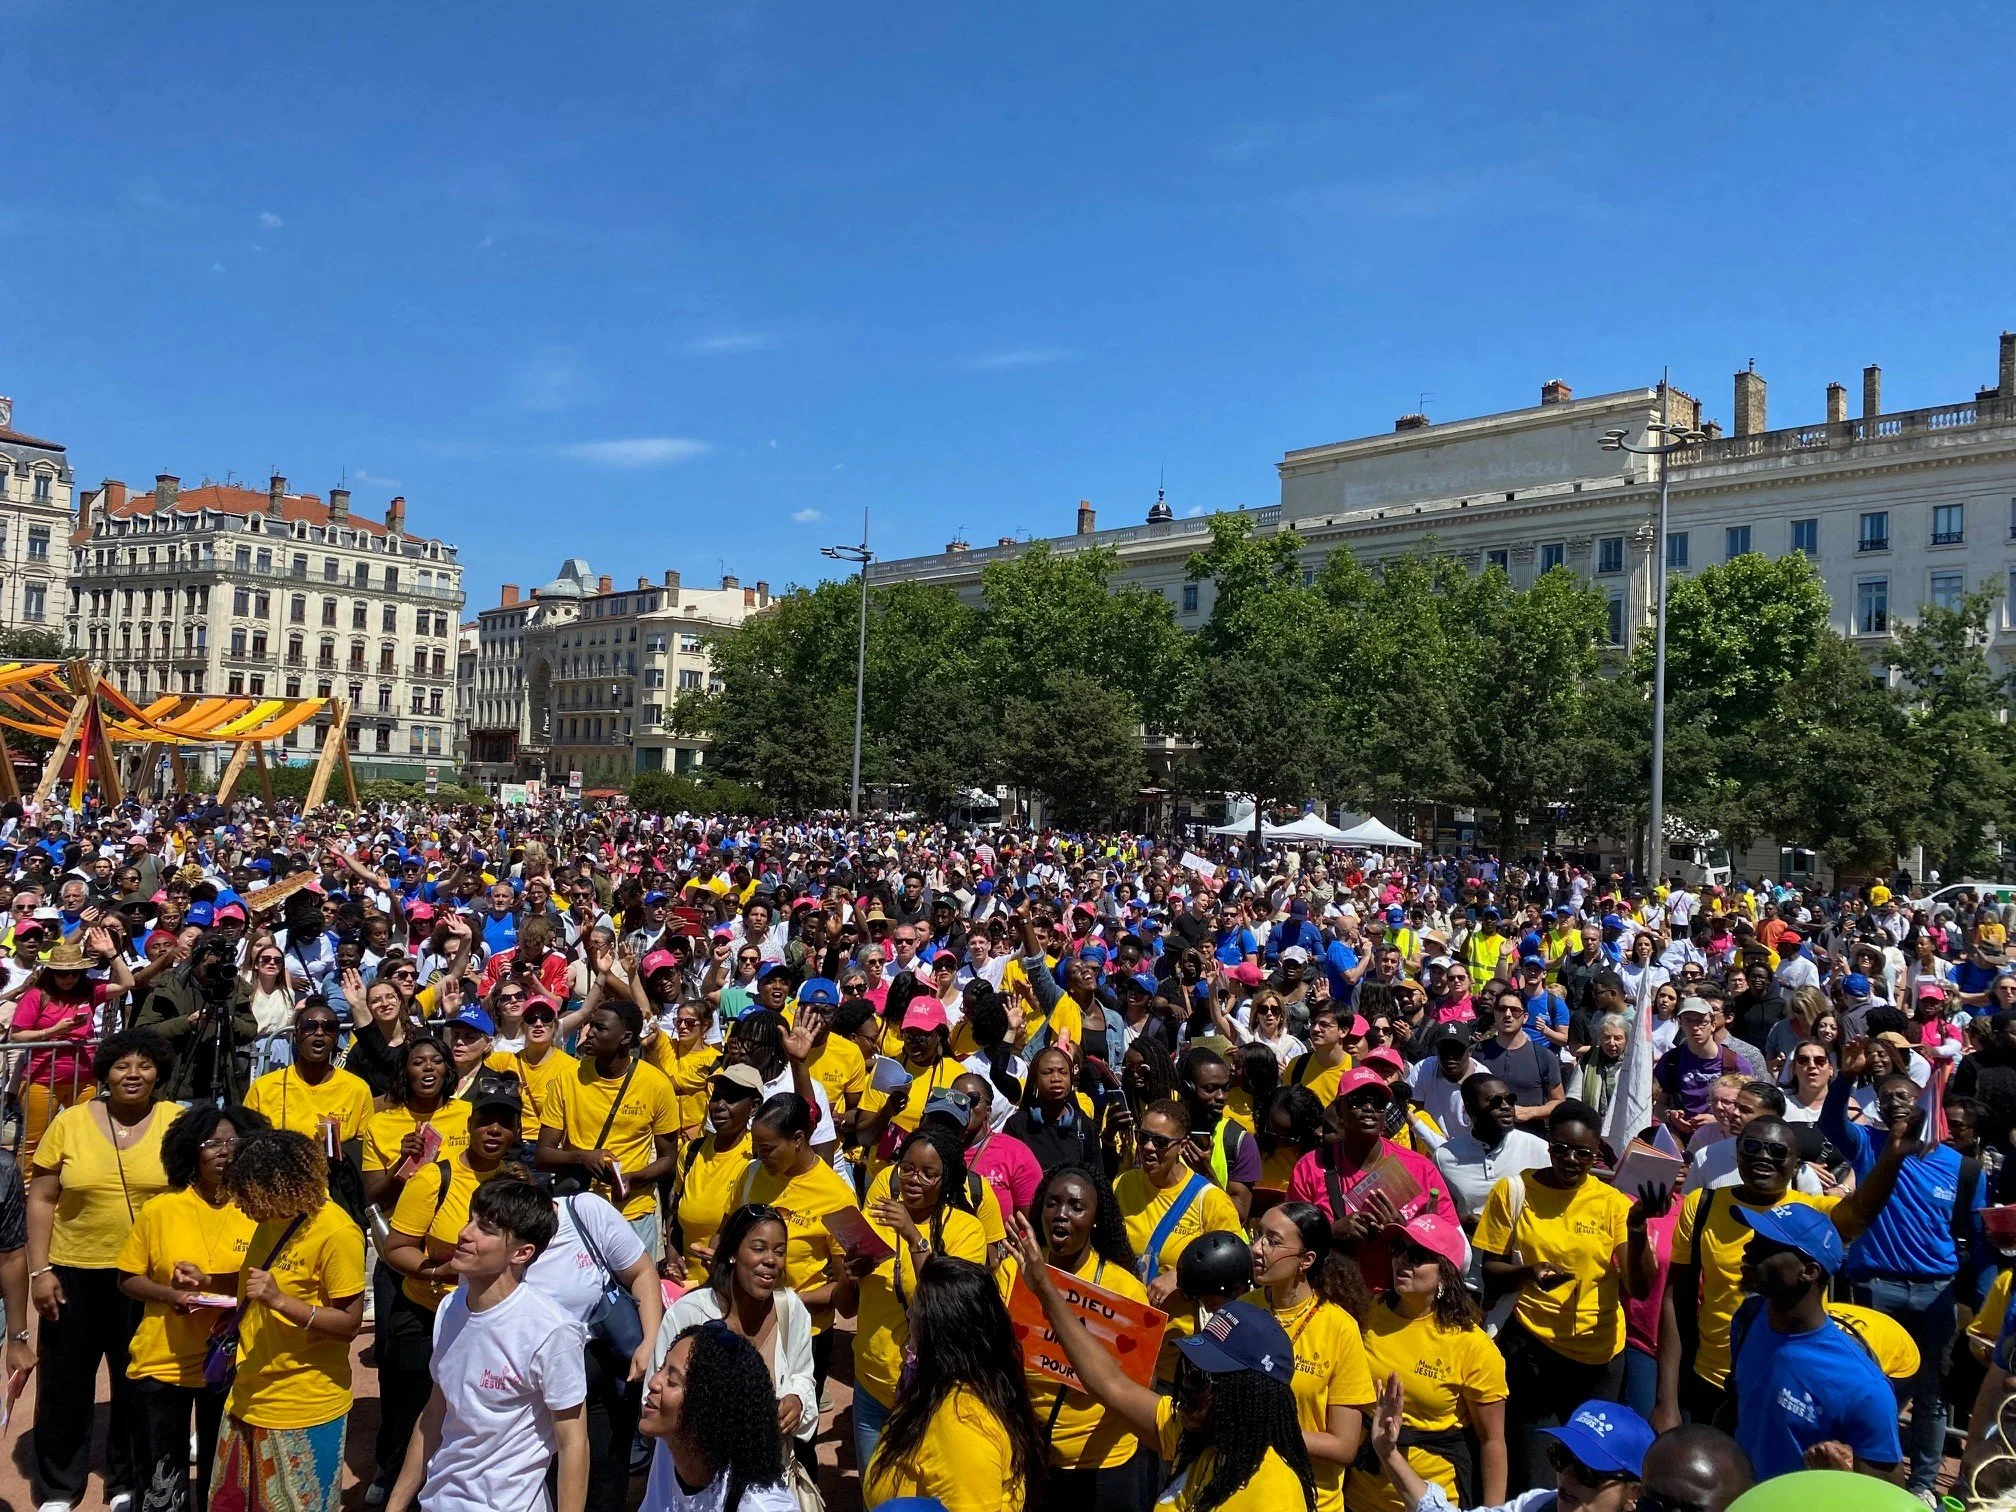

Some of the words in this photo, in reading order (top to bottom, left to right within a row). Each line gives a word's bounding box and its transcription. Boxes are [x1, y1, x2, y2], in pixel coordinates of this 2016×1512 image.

[1040, 1355, 1075, 1379] POUR
[1295, 1363, 1315, 1374] ESUS
[1414, 1367, 1438, 1379] JESUS
[480, 1378, 506, 1390] JESUS
[1777, 1395, 1805, 1417] JESUS
